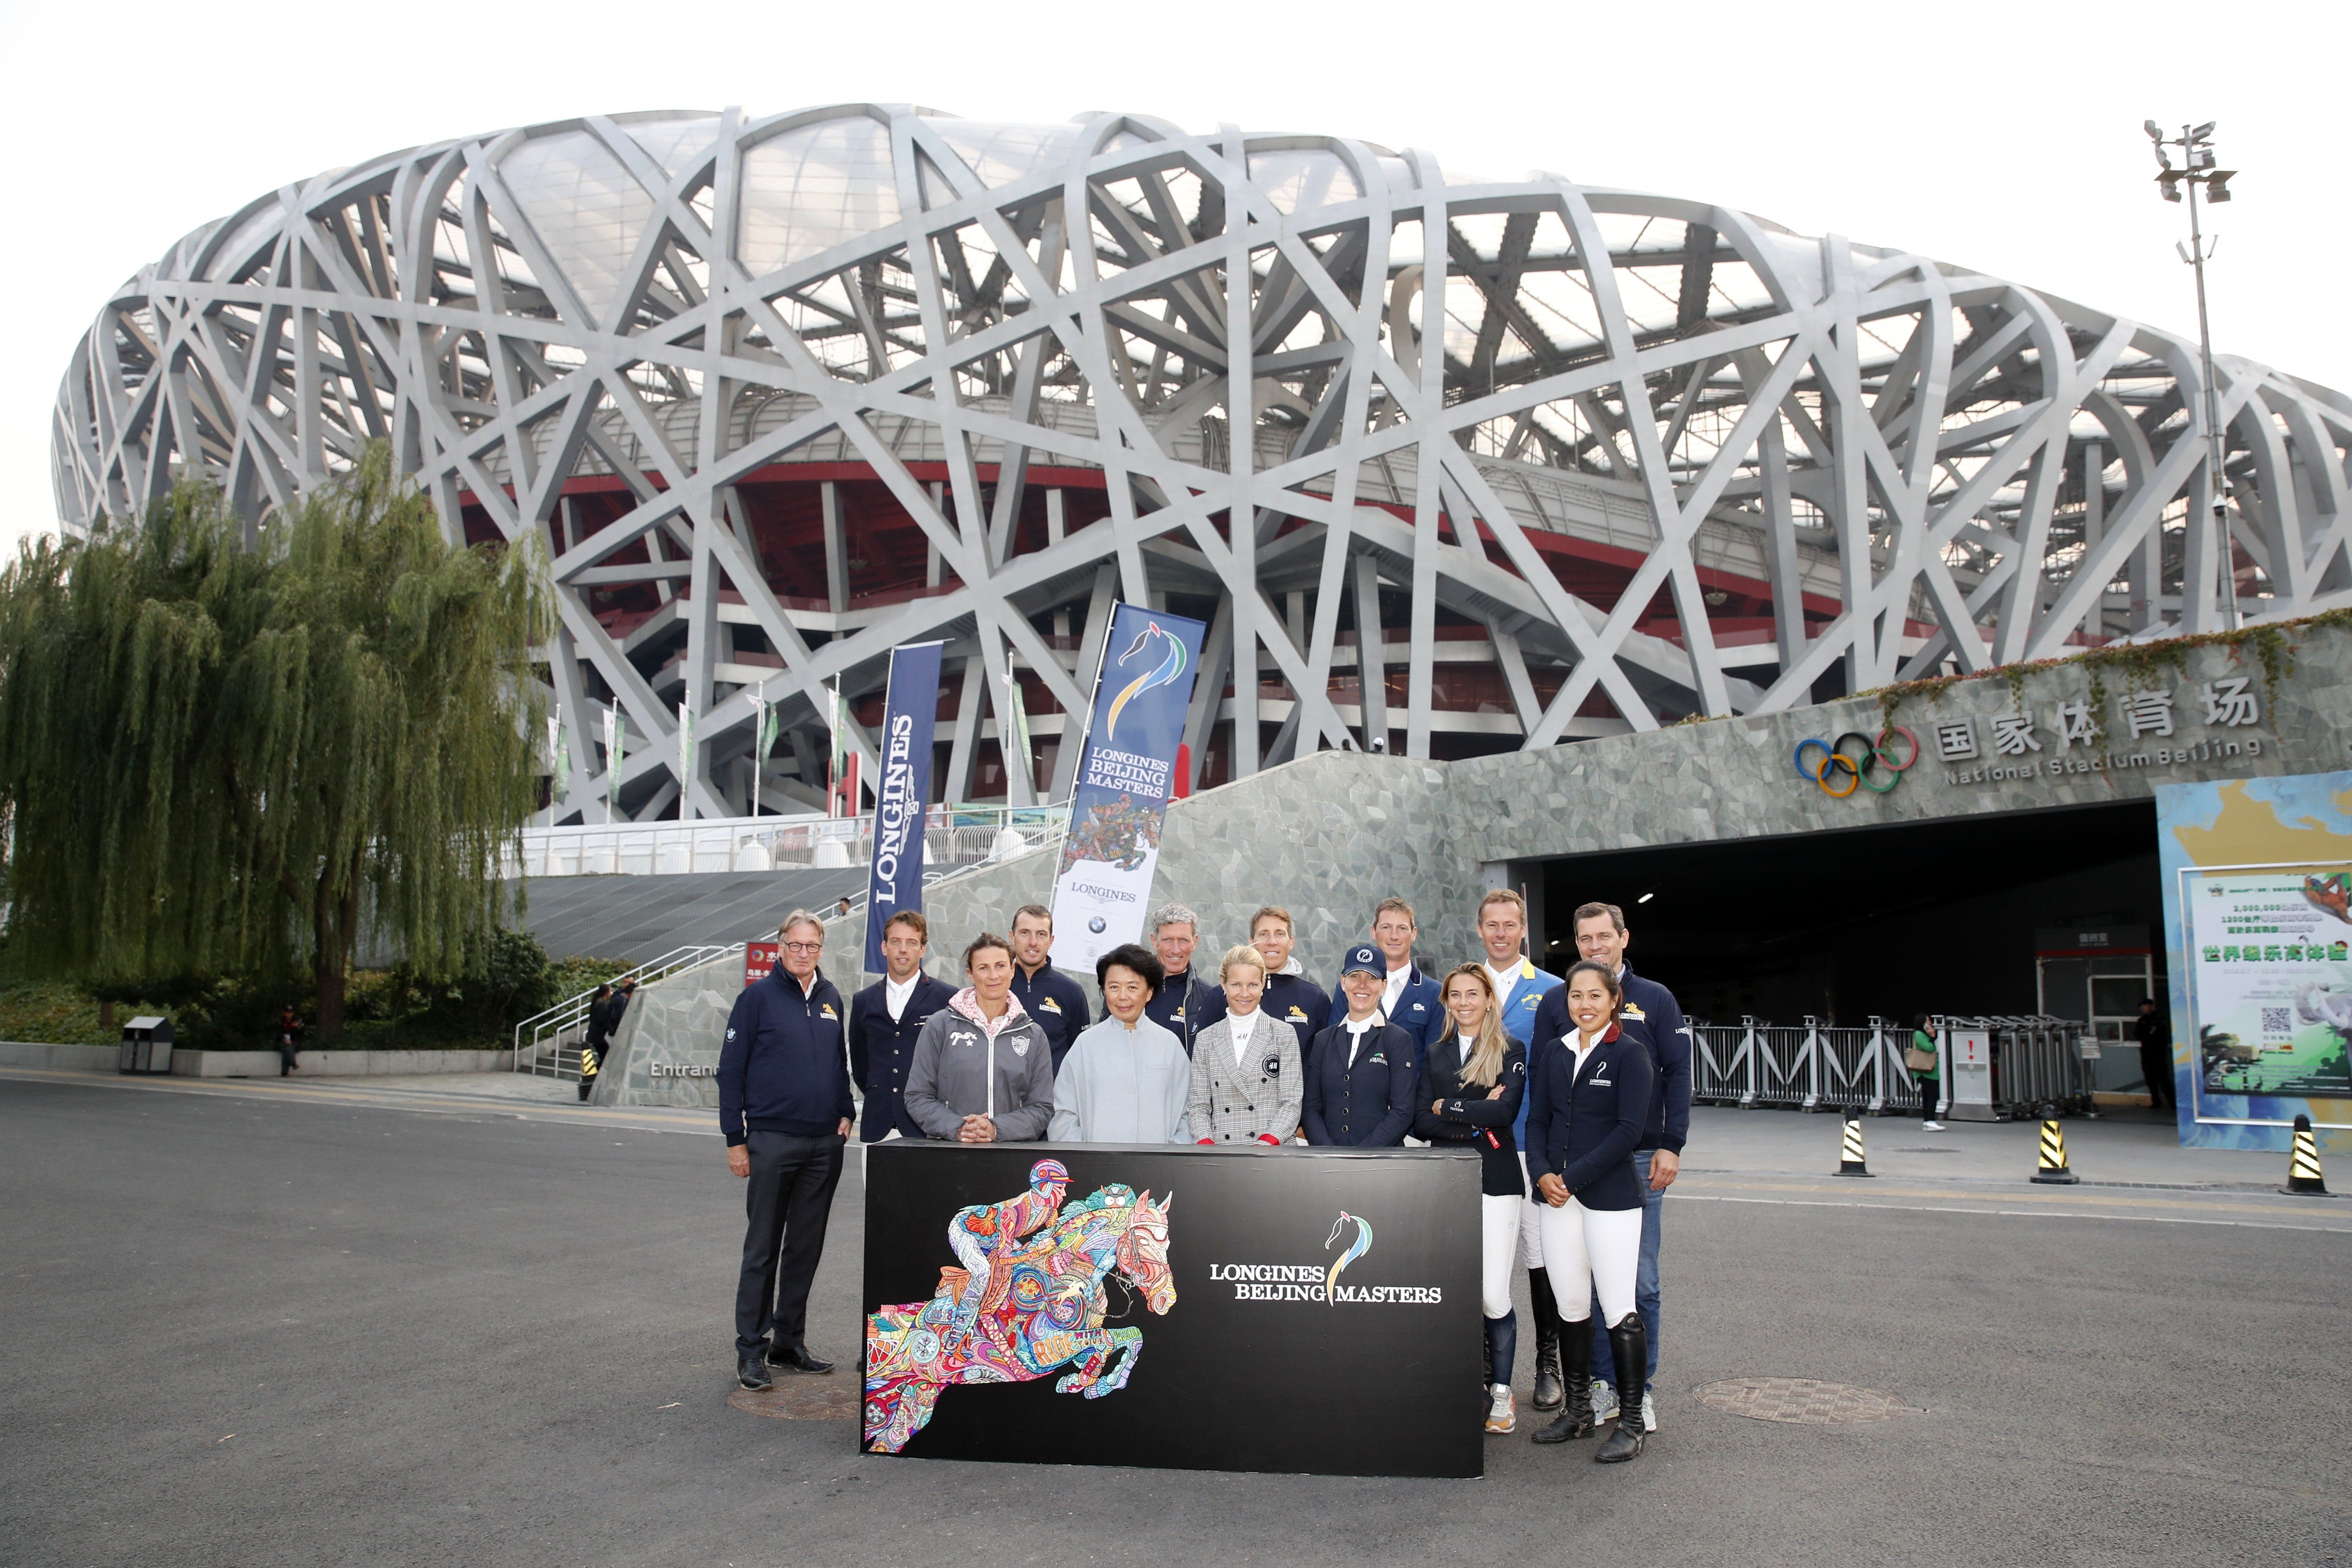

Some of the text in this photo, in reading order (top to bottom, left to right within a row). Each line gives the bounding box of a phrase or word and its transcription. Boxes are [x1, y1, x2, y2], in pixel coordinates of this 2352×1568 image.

[1934, 676, 2259, 762] 国家体育场
[1092, 747, 1169, 772] LONGINES
[1945, 738, 2261, 785] National Stadium Beijing
[1089, 759, 1166, 786] BEIJING
[1086, 772, 1164, 799] MASTERS
[876, 714, 913, 904] LONGINES
[1071, 882, 1136, 903] LONGINES
[999, 1252, 1039, 1265] CHAMPION
[1210, 1264, 1326, 1283] LONGINES
[1234, 1284, 1442, 1304] BEIJING MASTERS
[946, 1287, 984, 1350] CHEVAL
[1075, 1329, 1102, 1340] WITH
[1076, 1337, 1105, 1350] YOUR
[1112, 1327, 1142, 1343] PASSION
[1032, 1332, 1078, 1366] RIDE
